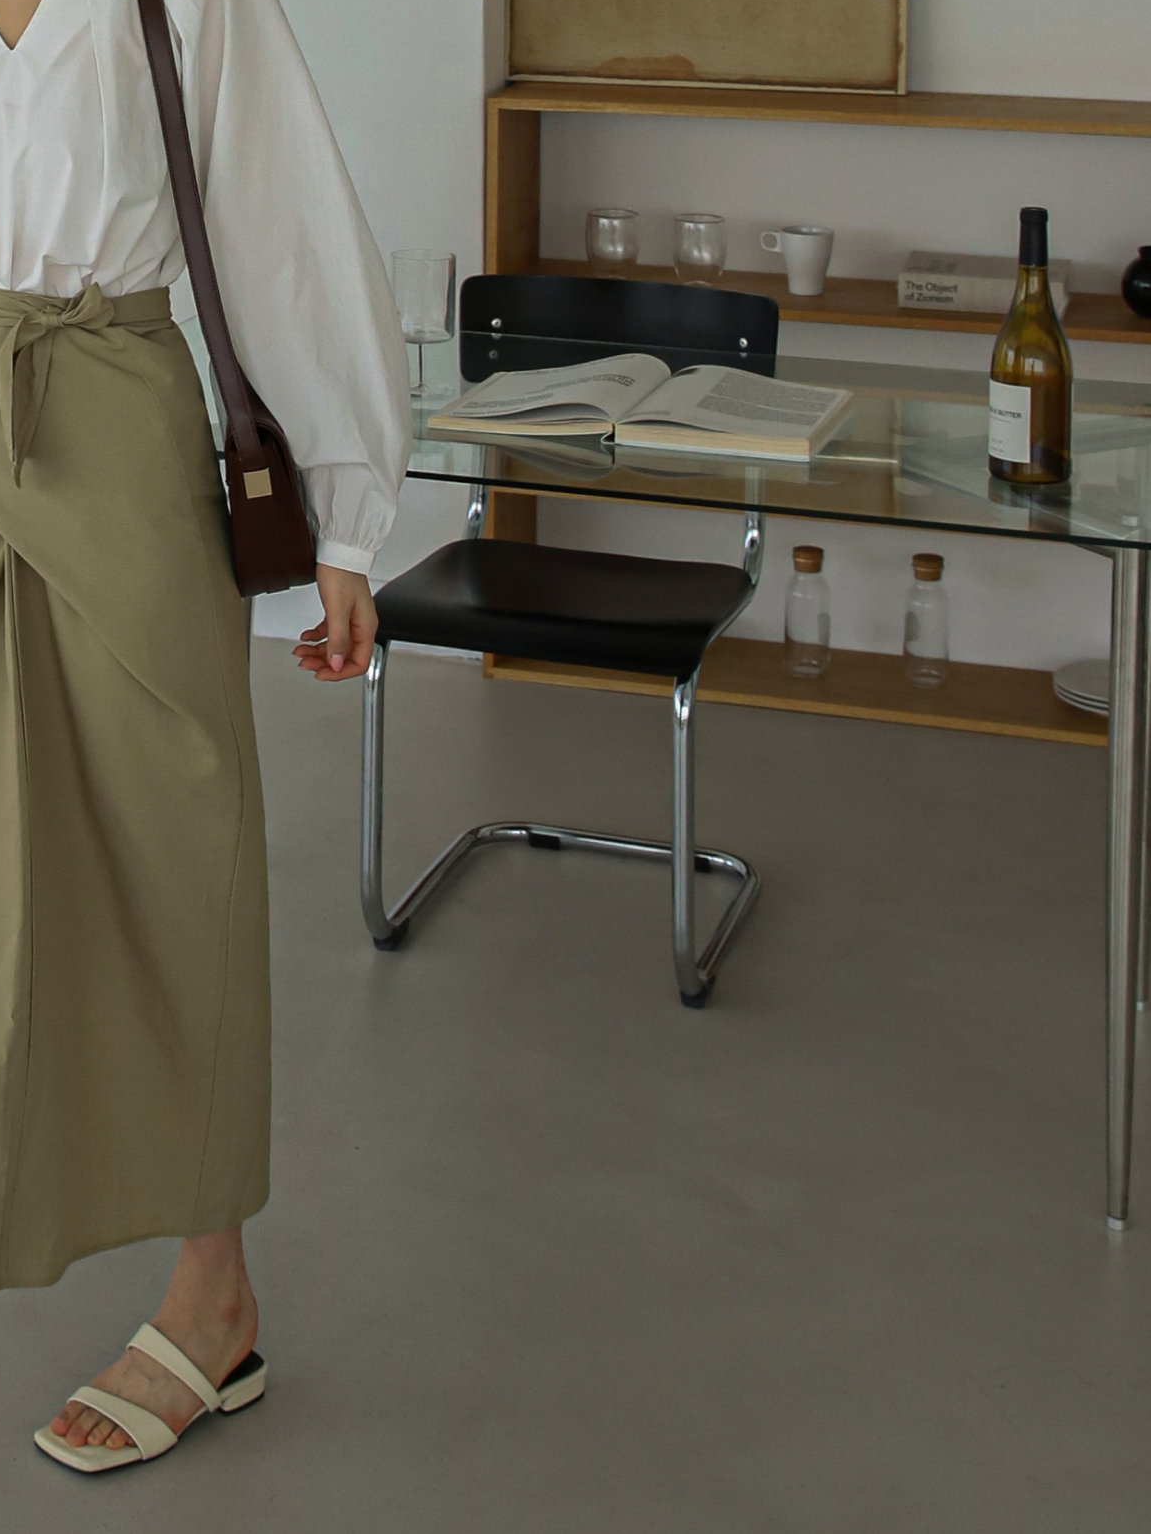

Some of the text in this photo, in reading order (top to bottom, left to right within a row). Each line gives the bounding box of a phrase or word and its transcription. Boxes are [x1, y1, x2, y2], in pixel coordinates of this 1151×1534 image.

[905, 280, 957, 295] The Object
[904, 292, 914, 301] of
